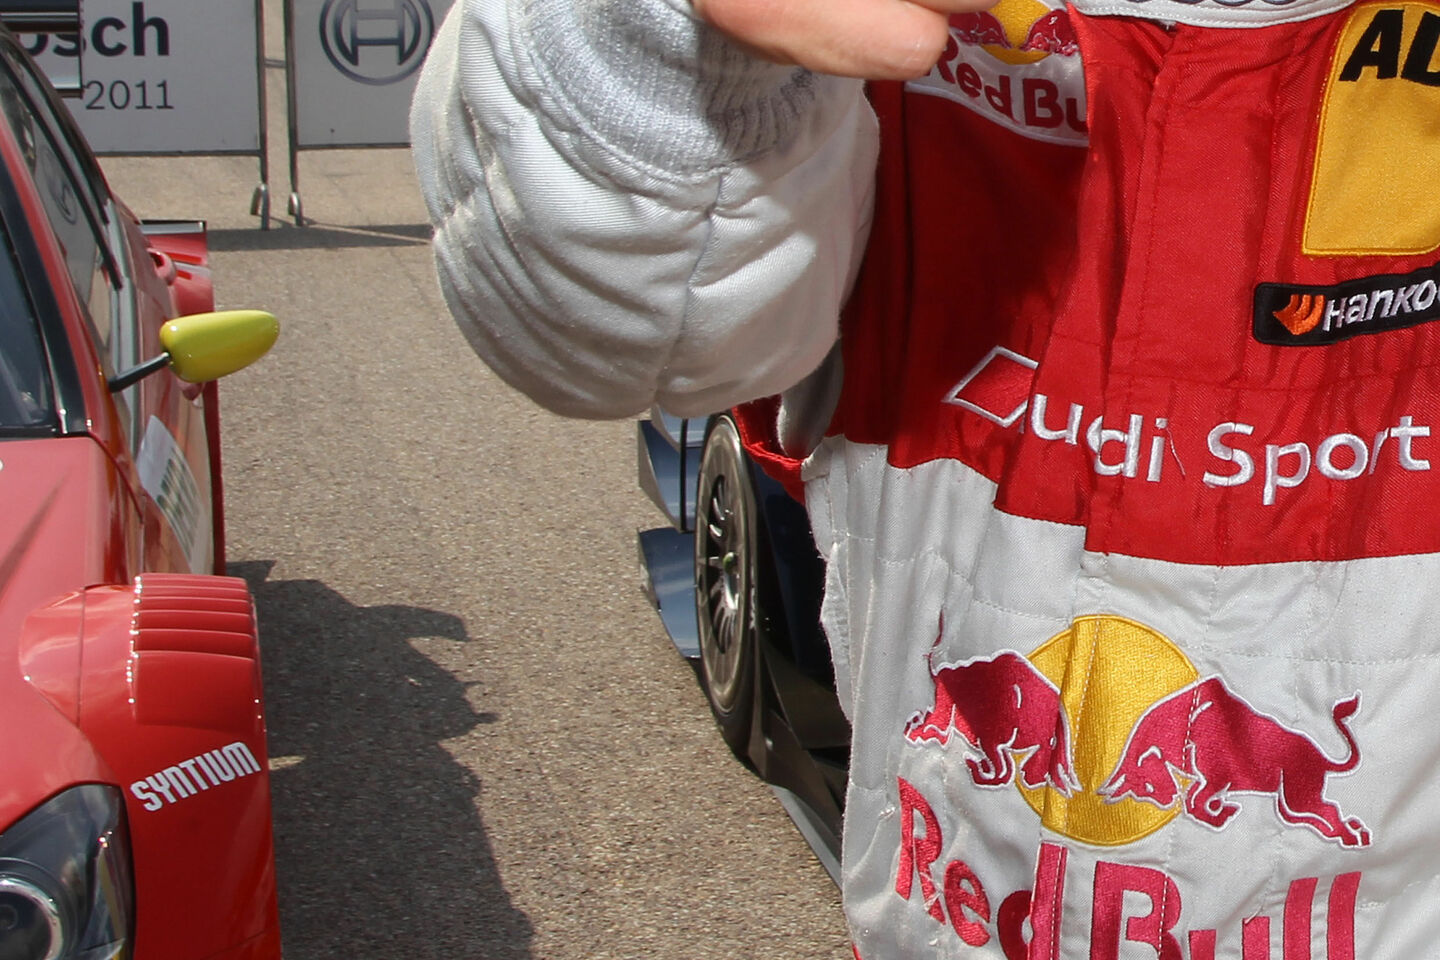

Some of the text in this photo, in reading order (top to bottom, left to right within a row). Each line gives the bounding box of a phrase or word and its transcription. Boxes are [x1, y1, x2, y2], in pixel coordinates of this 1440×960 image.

[86, 80, 174, 110] 2011
[1019, 393, 1431, 506] udi Sport
[130, 742, 261, 811] SYNTIUM
[895, 776, 1066, 960] Red
